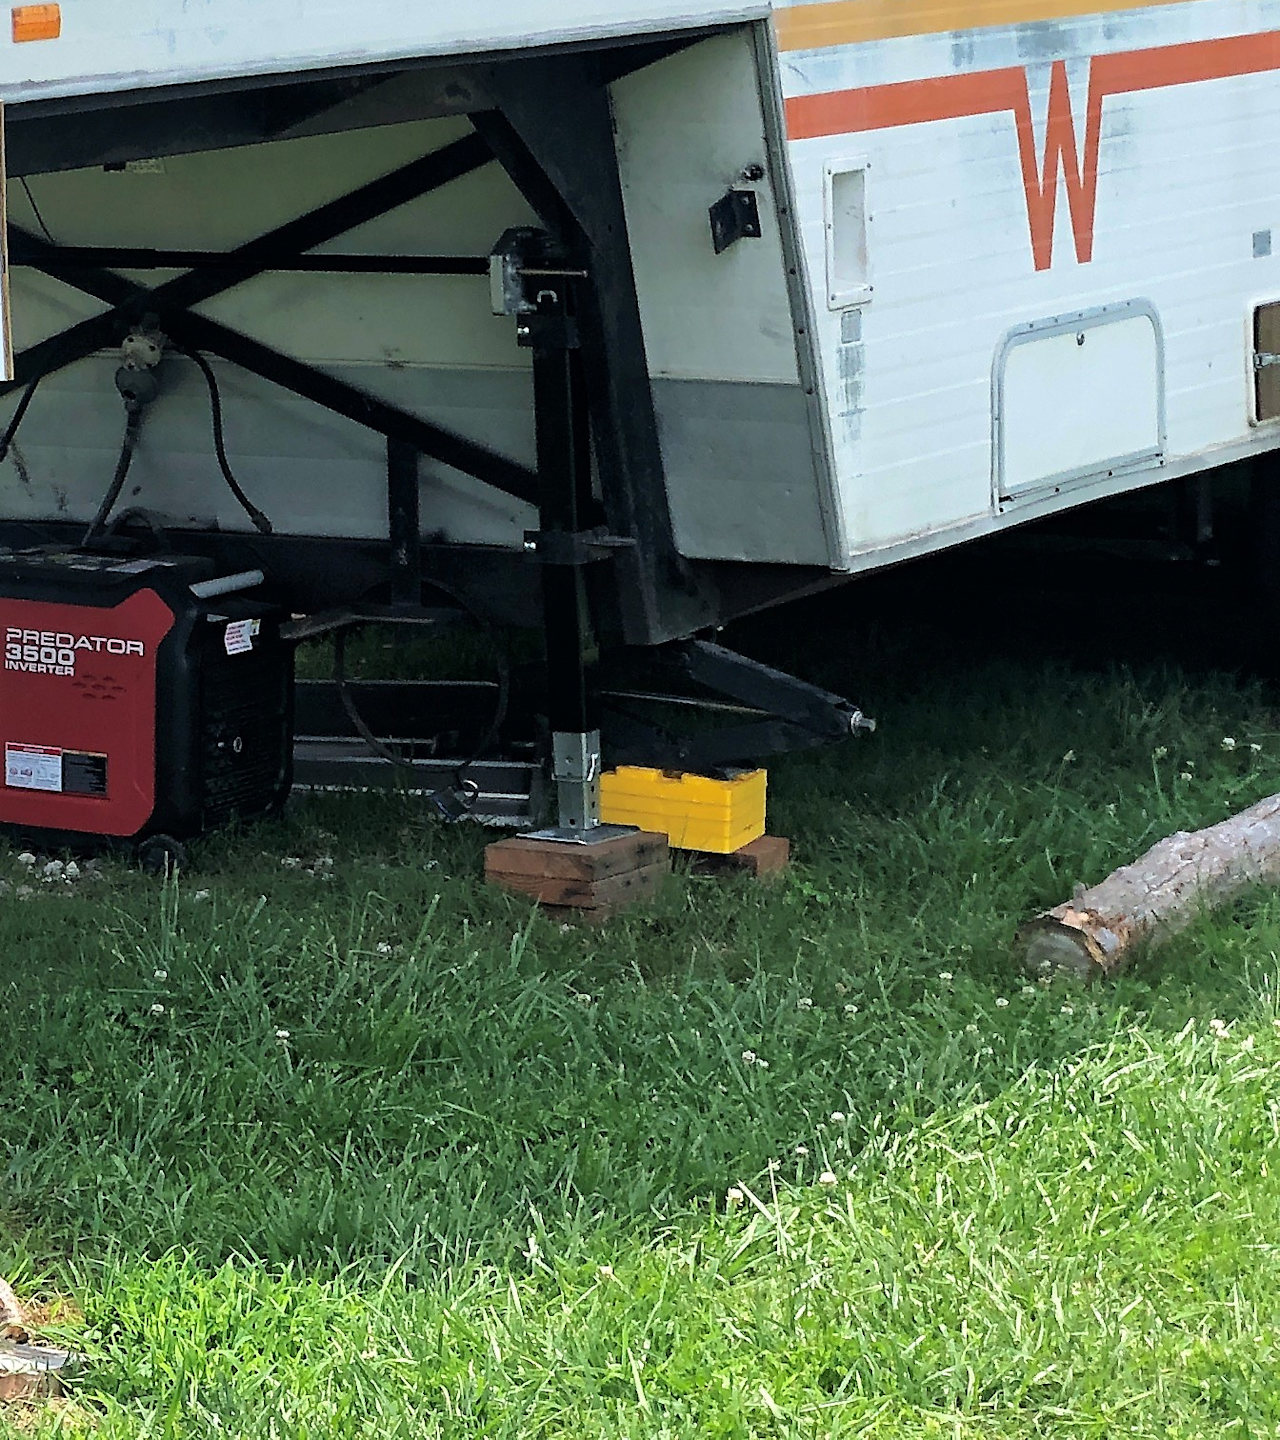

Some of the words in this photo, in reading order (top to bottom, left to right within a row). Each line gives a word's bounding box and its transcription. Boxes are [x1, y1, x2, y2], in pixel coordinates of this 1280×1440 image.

[6, 627, 144, 656] PREDATOR
[5, 643, 75, 666] 3500
[4, 660, 75, 677] INVERTER
